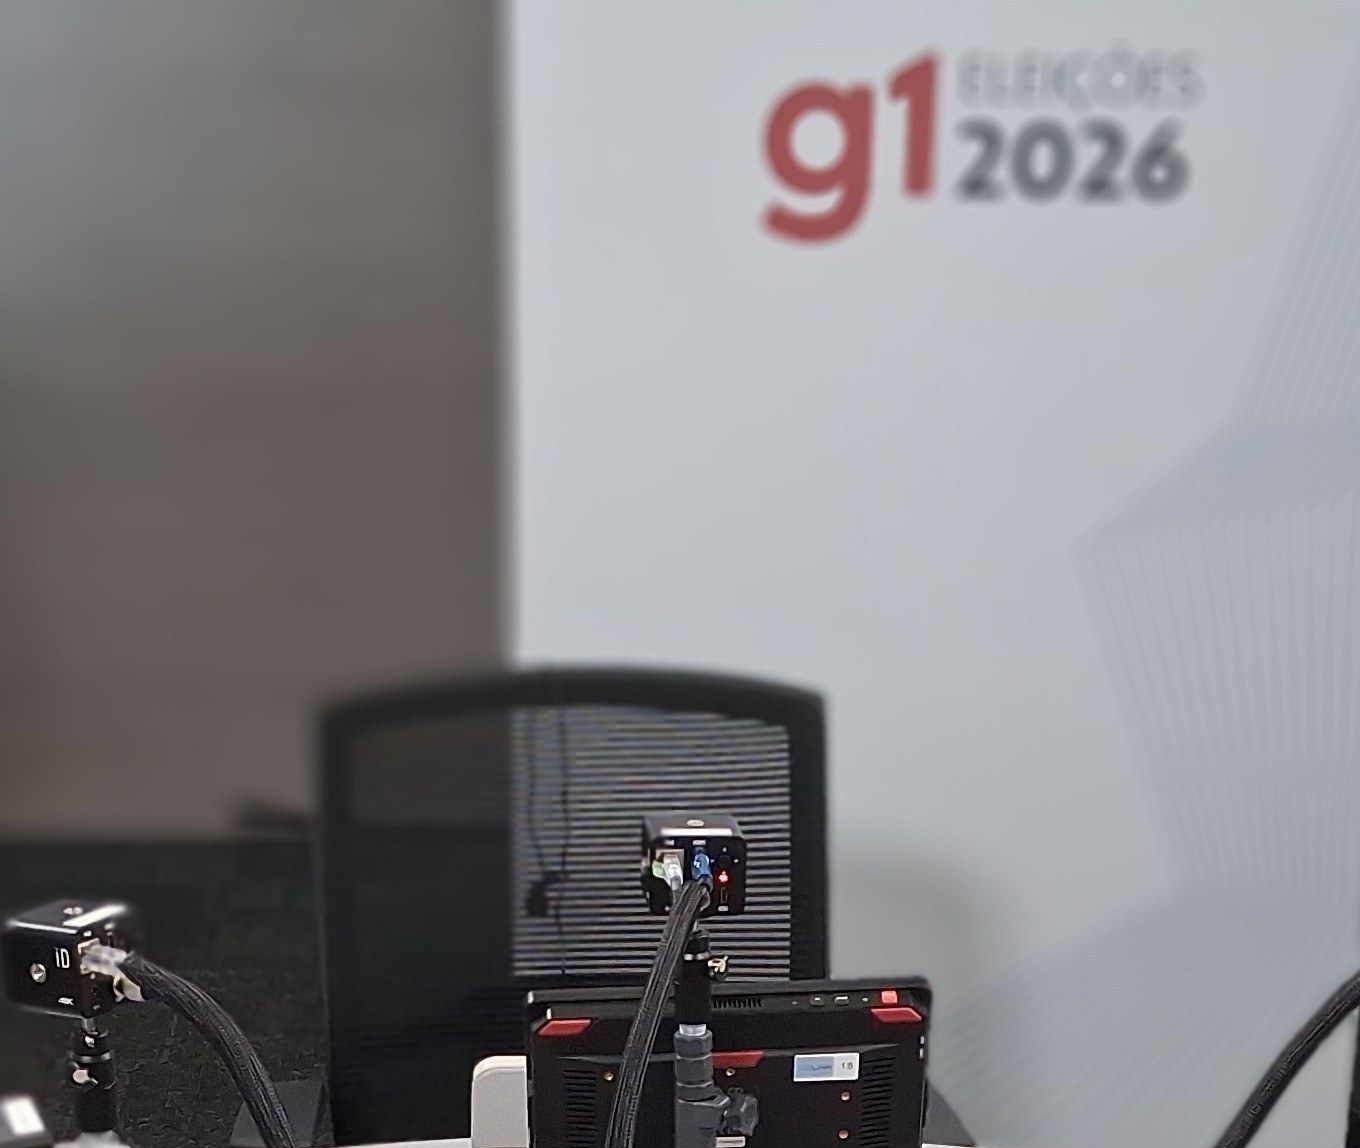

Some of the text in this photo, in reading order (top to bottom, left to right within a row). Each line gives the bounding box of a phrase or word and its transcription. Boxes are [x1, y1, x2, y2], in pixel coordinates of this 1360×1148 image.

[956, 42, 1207, 110] ELEIÇÕES
[764, 50, 937, 242] g1
[953, 117, 1191, 203] 2026
